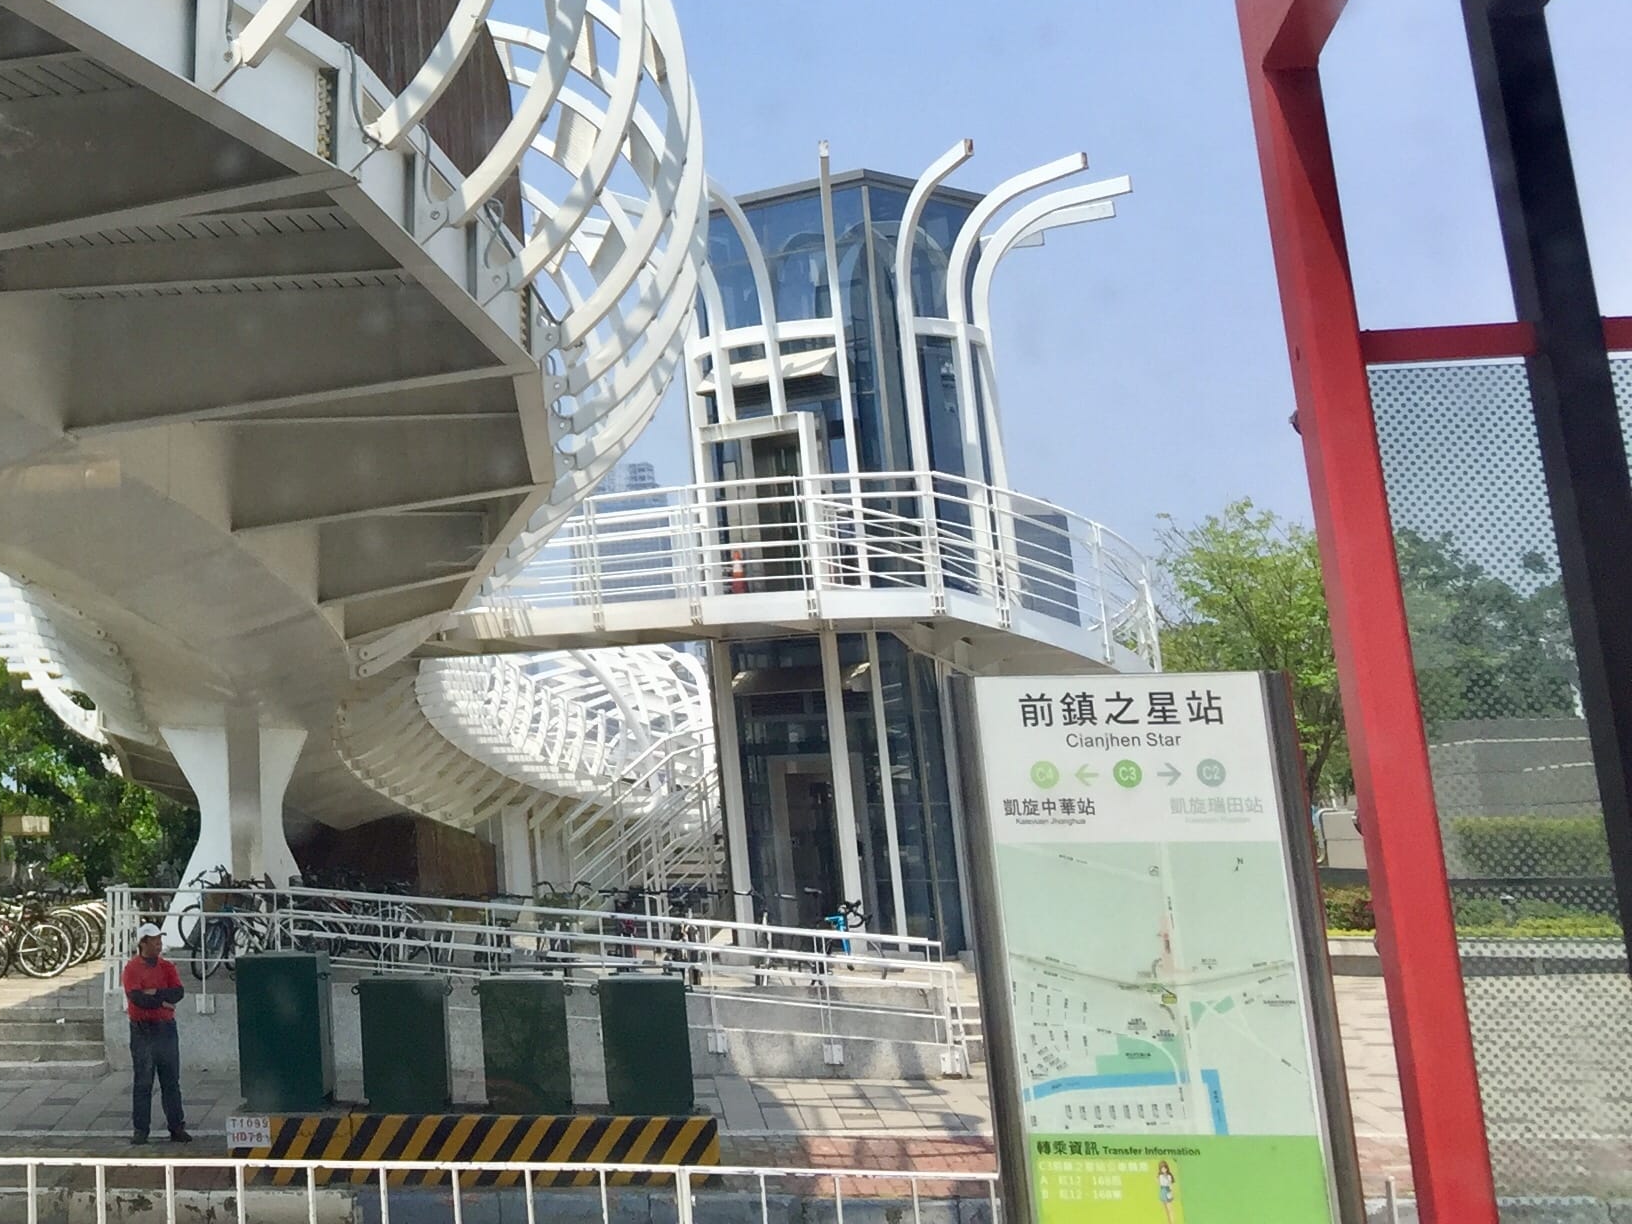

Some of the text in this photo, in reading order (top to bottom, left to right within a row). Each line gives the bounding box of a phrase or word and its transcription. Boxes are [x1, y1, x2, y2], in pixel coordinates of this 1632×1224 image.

[1018, 689, 1224, 728] 前鎮之星站
[1065, 732, 1182, 751] Cianjhen Star
[1119, 766, 1137, 782] C3
[1202, 765, 1220, 781] C2
[1003, 797, 1096, 816] 凱旋中華站
[1036, 1140, 1201, 1156] 轉乘資訊 Transfer Information
